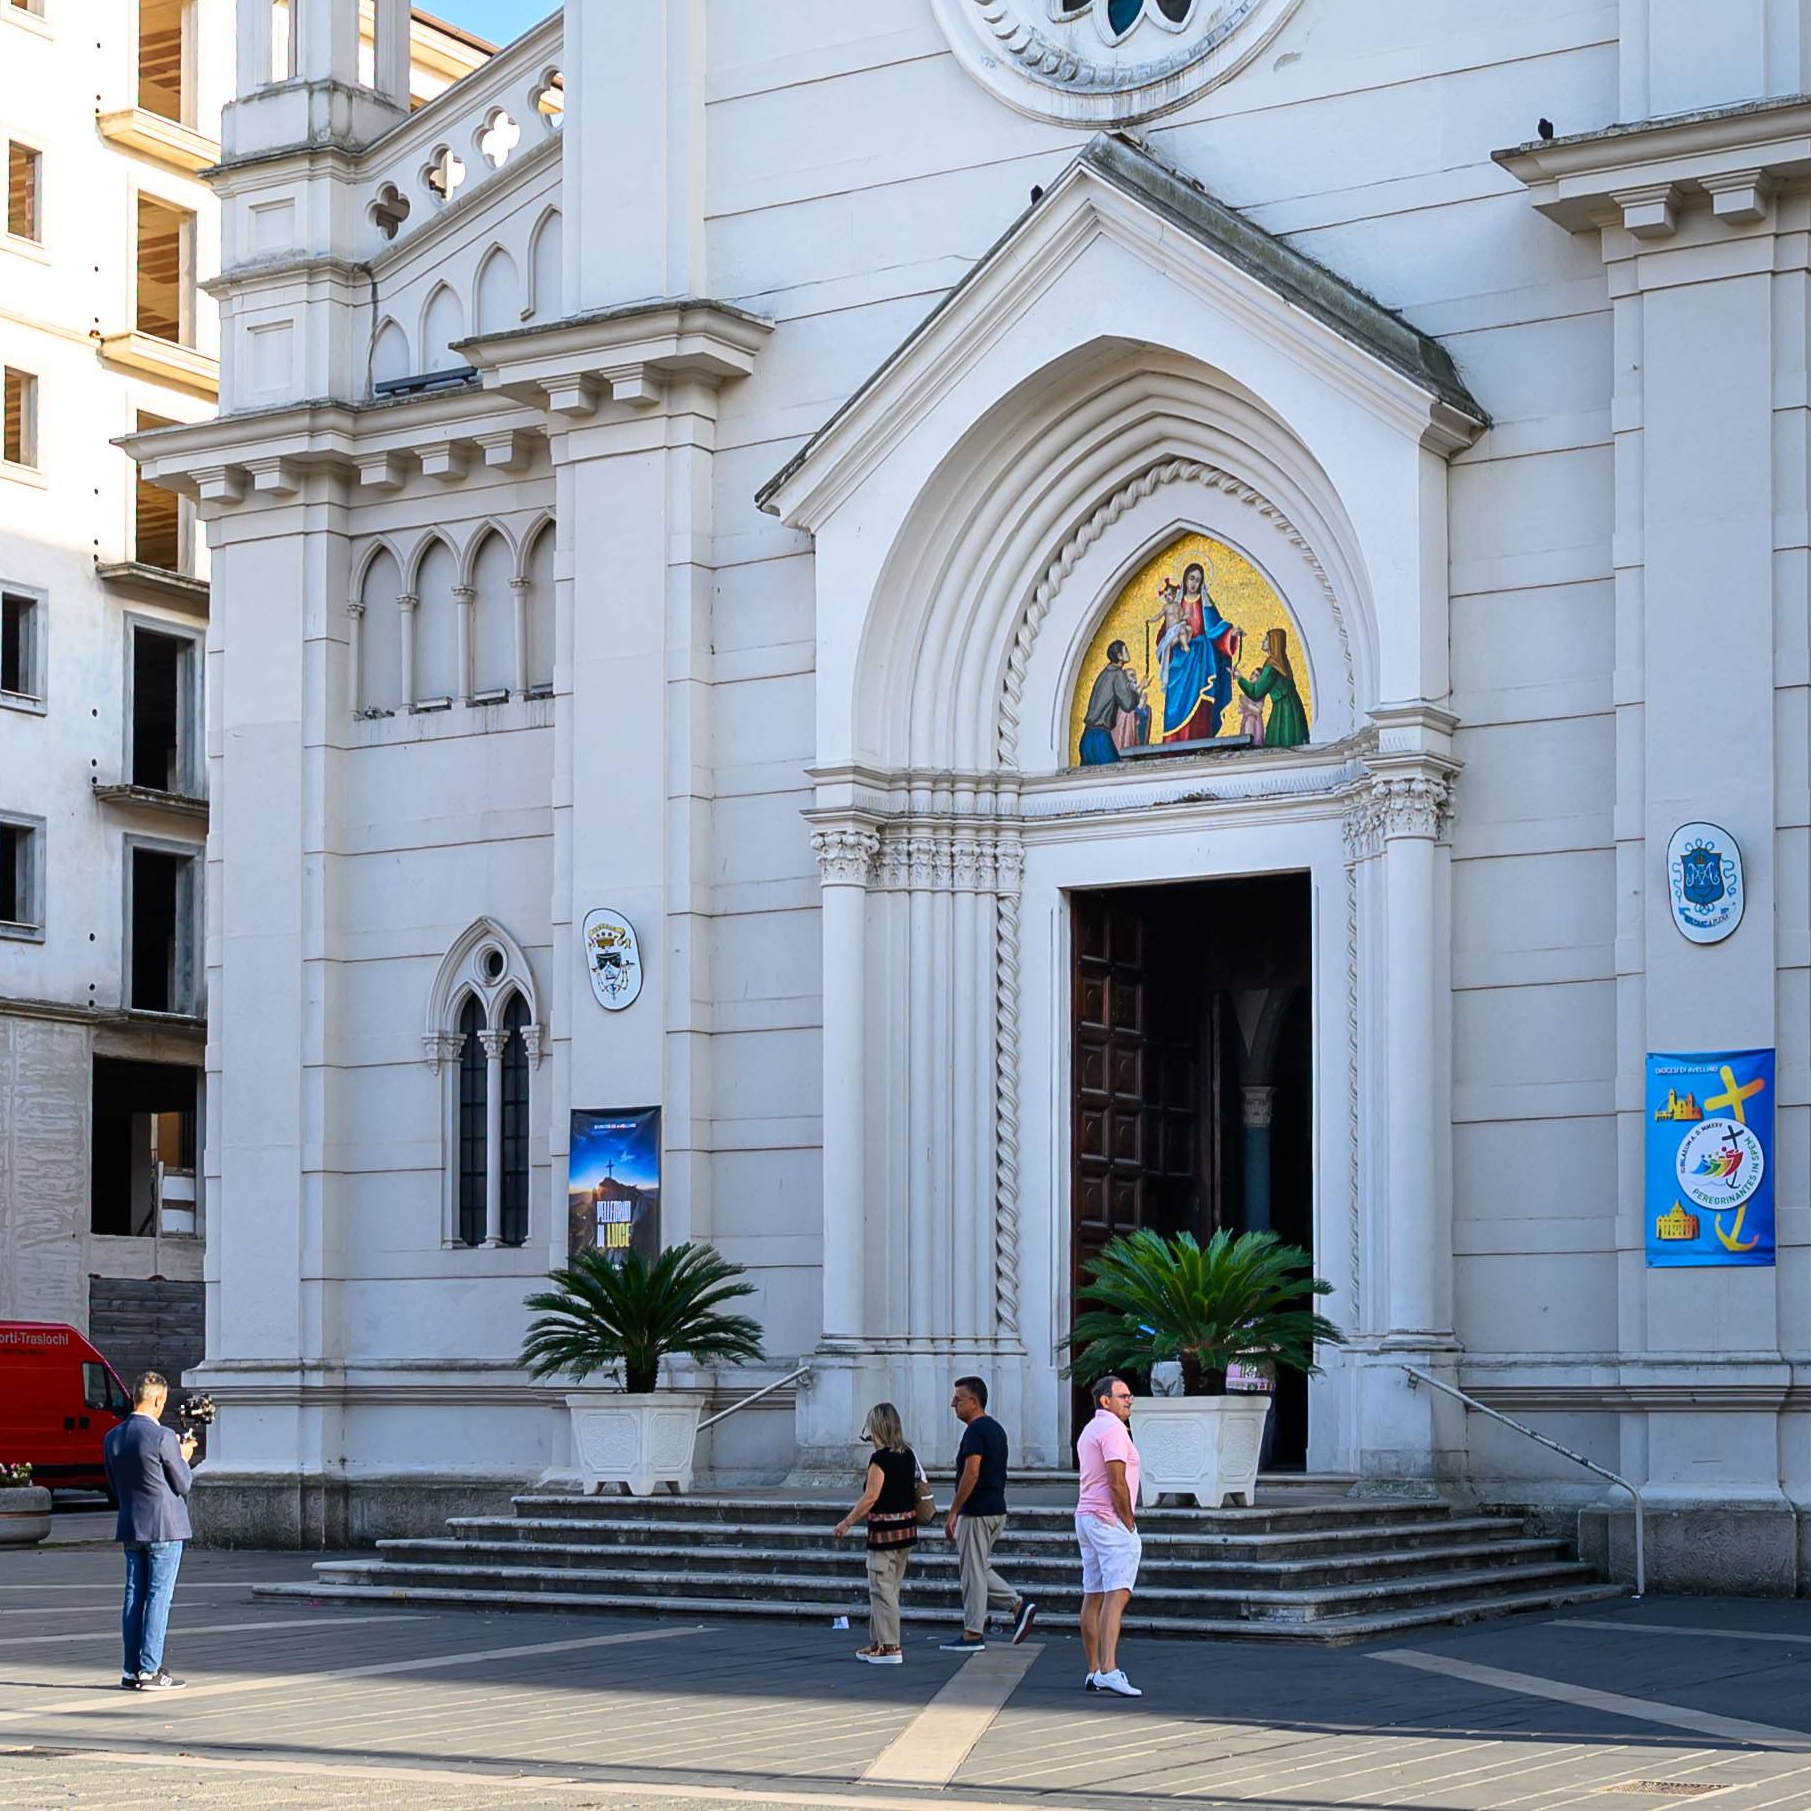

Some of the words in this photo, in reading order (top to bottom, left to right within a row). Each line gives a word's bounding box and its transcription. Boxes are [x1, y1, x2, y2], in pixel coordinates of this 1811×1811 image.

[1744, 1136, 1760, 1165] SPEM
[1753, 1165, 1760, 1174] IN
[1692, 1174, 1757, 1205] PEREGRINANTES
[607, 1222, 631, 1248] LUCE
